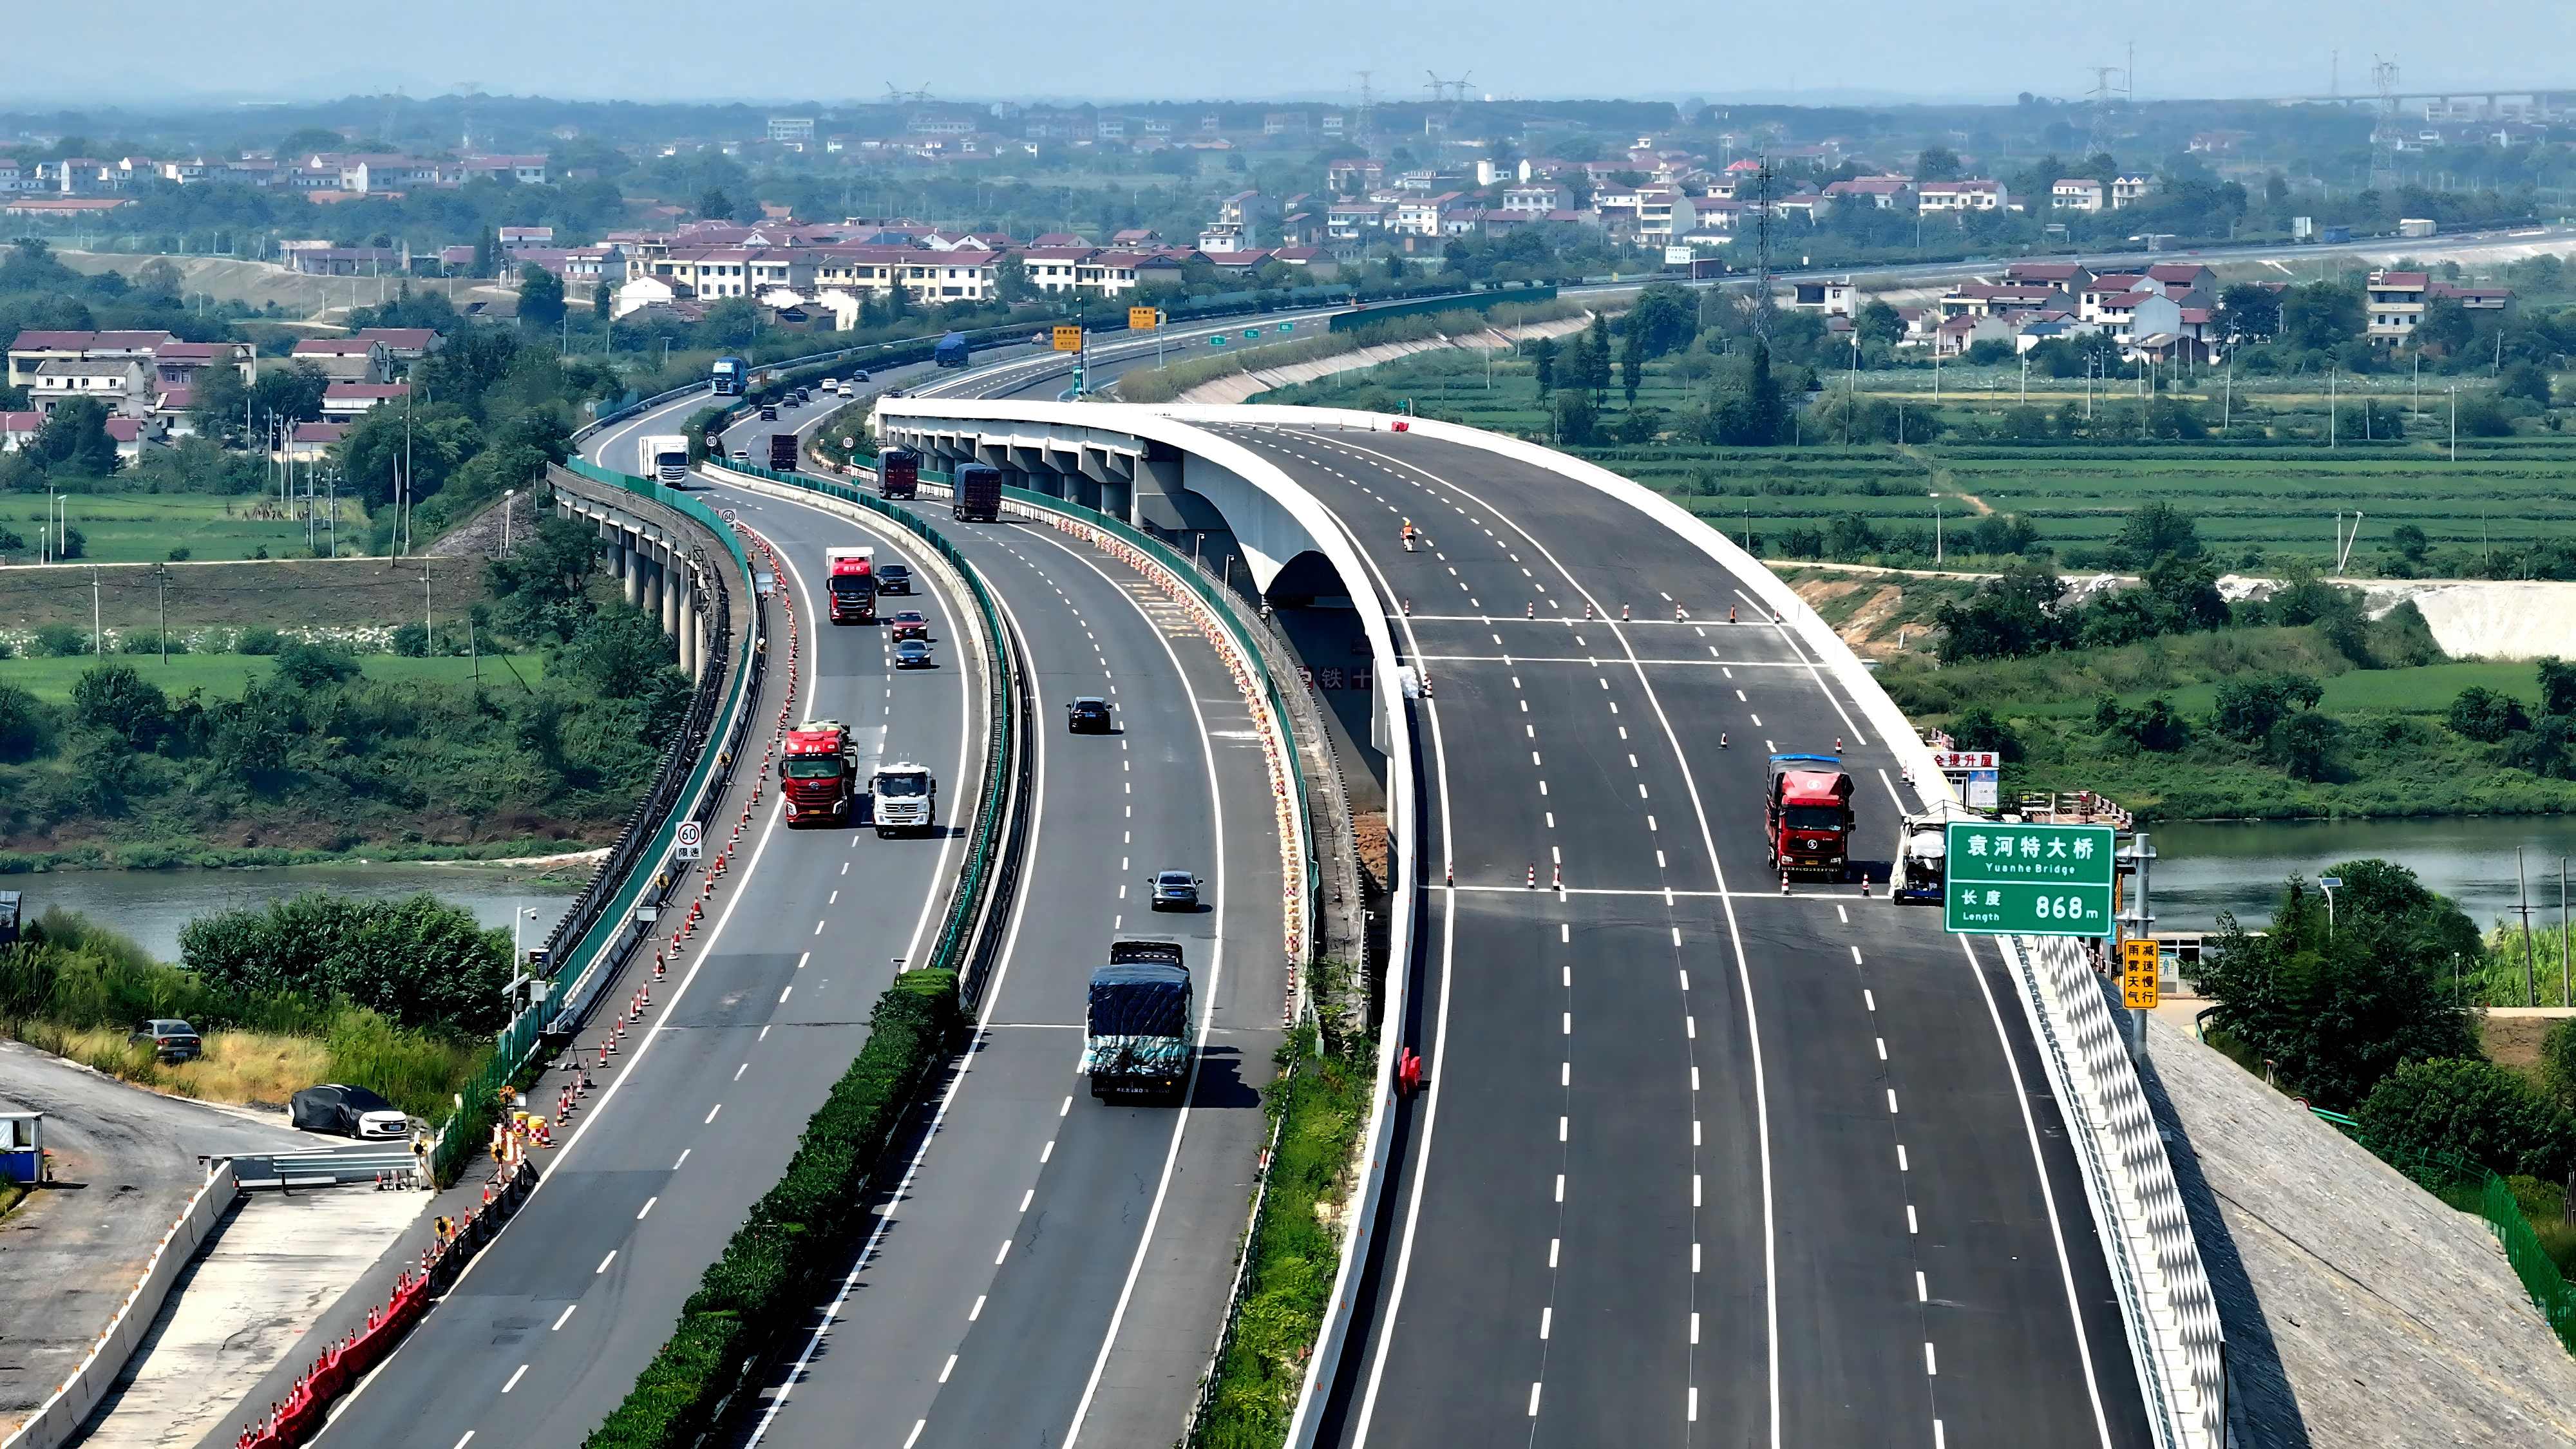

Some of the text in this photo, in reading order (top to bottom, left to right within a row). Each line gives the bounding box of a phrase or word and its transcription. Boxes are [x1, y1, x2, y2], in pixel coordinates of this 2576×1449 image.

[682, 828, 696, 840] 60
[679, 848, 699, 857] 限速
[1967, 835, 2094, 860] 袁河特大桥
[1985, 863, 2075, 876] Yuanhe Bridge
[1962, 889, 2001, 906] 长度
[1963, 912, 2000, 923] Length
[2128, 945, 2139, 1003] 雨雾天气
[2143, 945, 2154, 1003] 减速慢行
